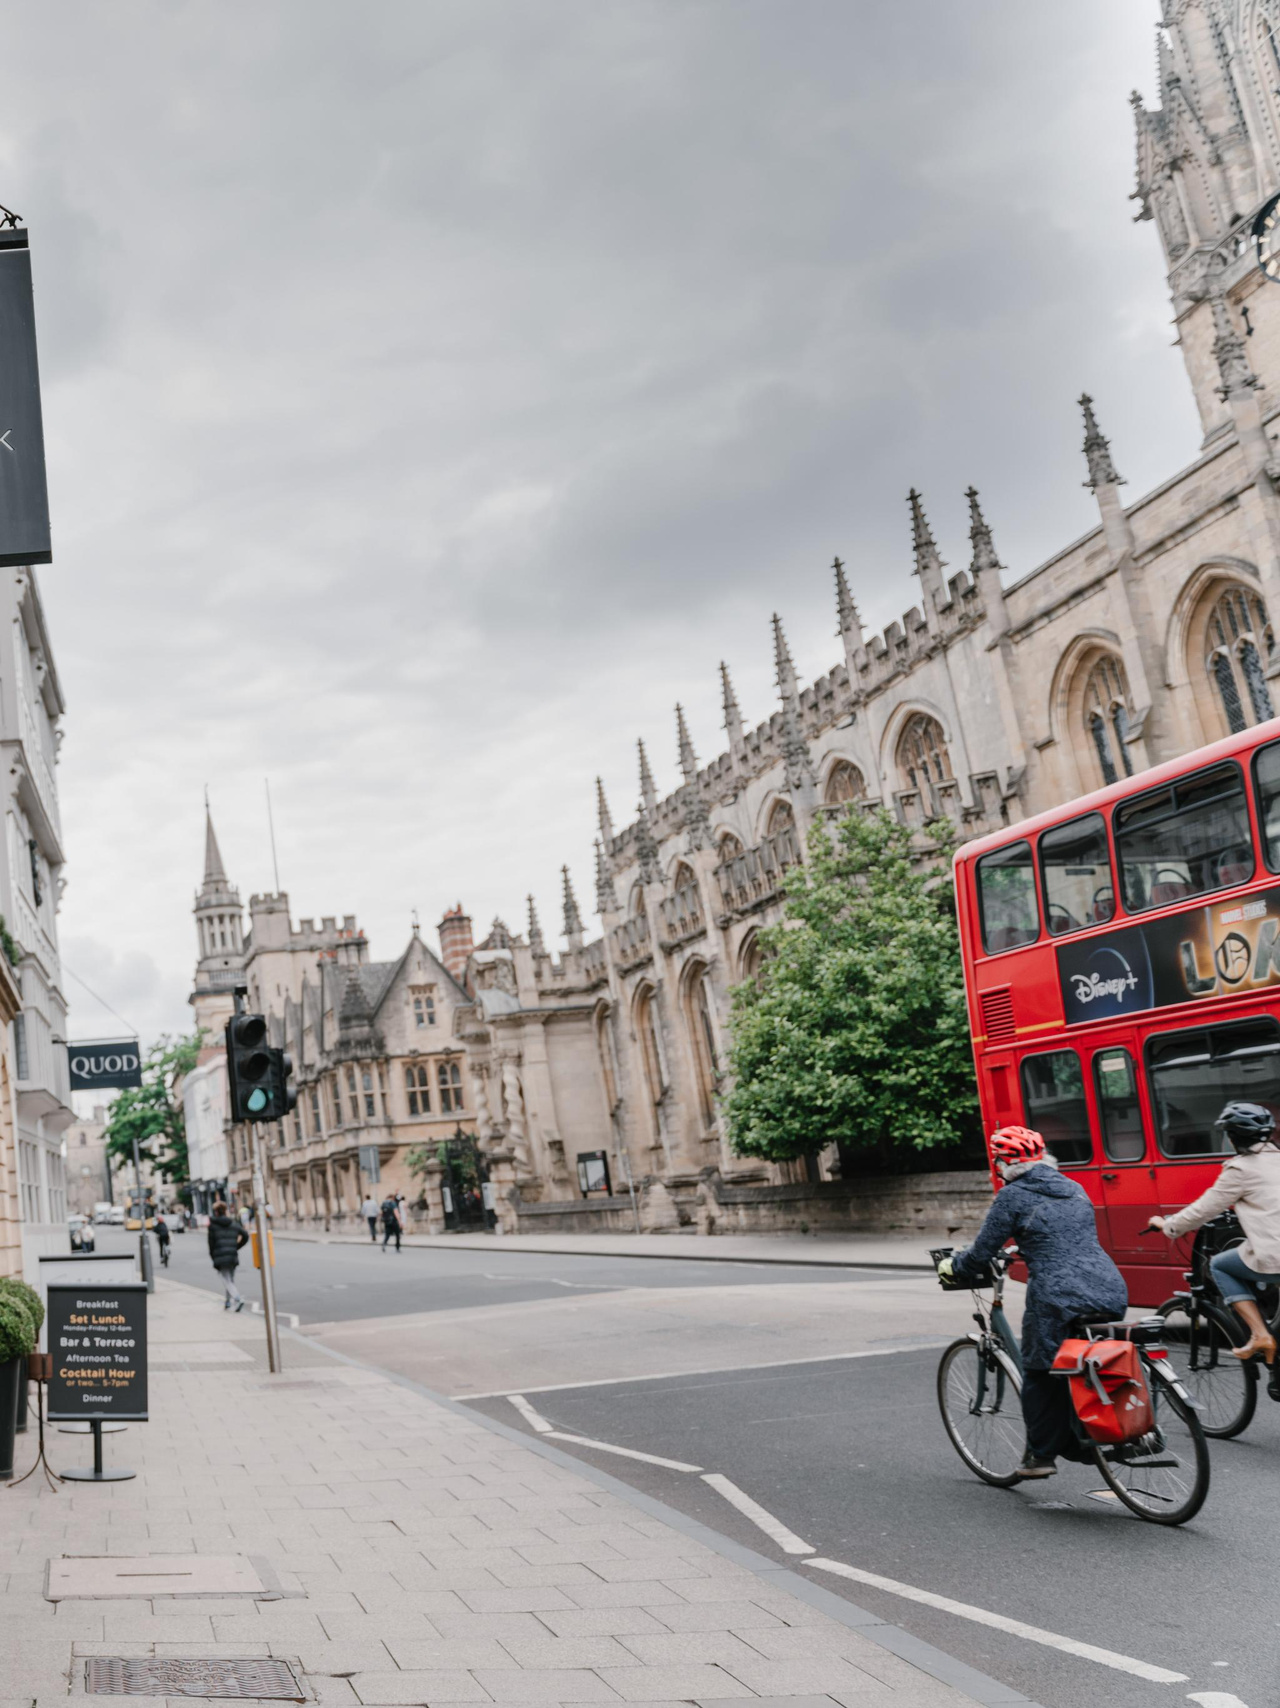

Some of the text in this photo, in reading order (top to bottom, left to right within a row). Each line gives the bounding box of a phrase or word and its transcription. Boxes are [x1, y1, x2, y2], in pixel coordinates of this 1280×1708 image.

[70, 1054, 139, 1079] QUOD
[76, 1300, 119, 1309] Breakfast
[69, 1314, 125, 1324] Set Lunch
[60, 1337, 136, 1347] Bar & Terrace
[66, 1354, 129, 1363] Afternoon Tea
[59, 1368, 136, 1378] Cocktail Hour
[102, 1379, 129, 1388] 5-7pm
[82, 1393, 113, 1403] Dinner
